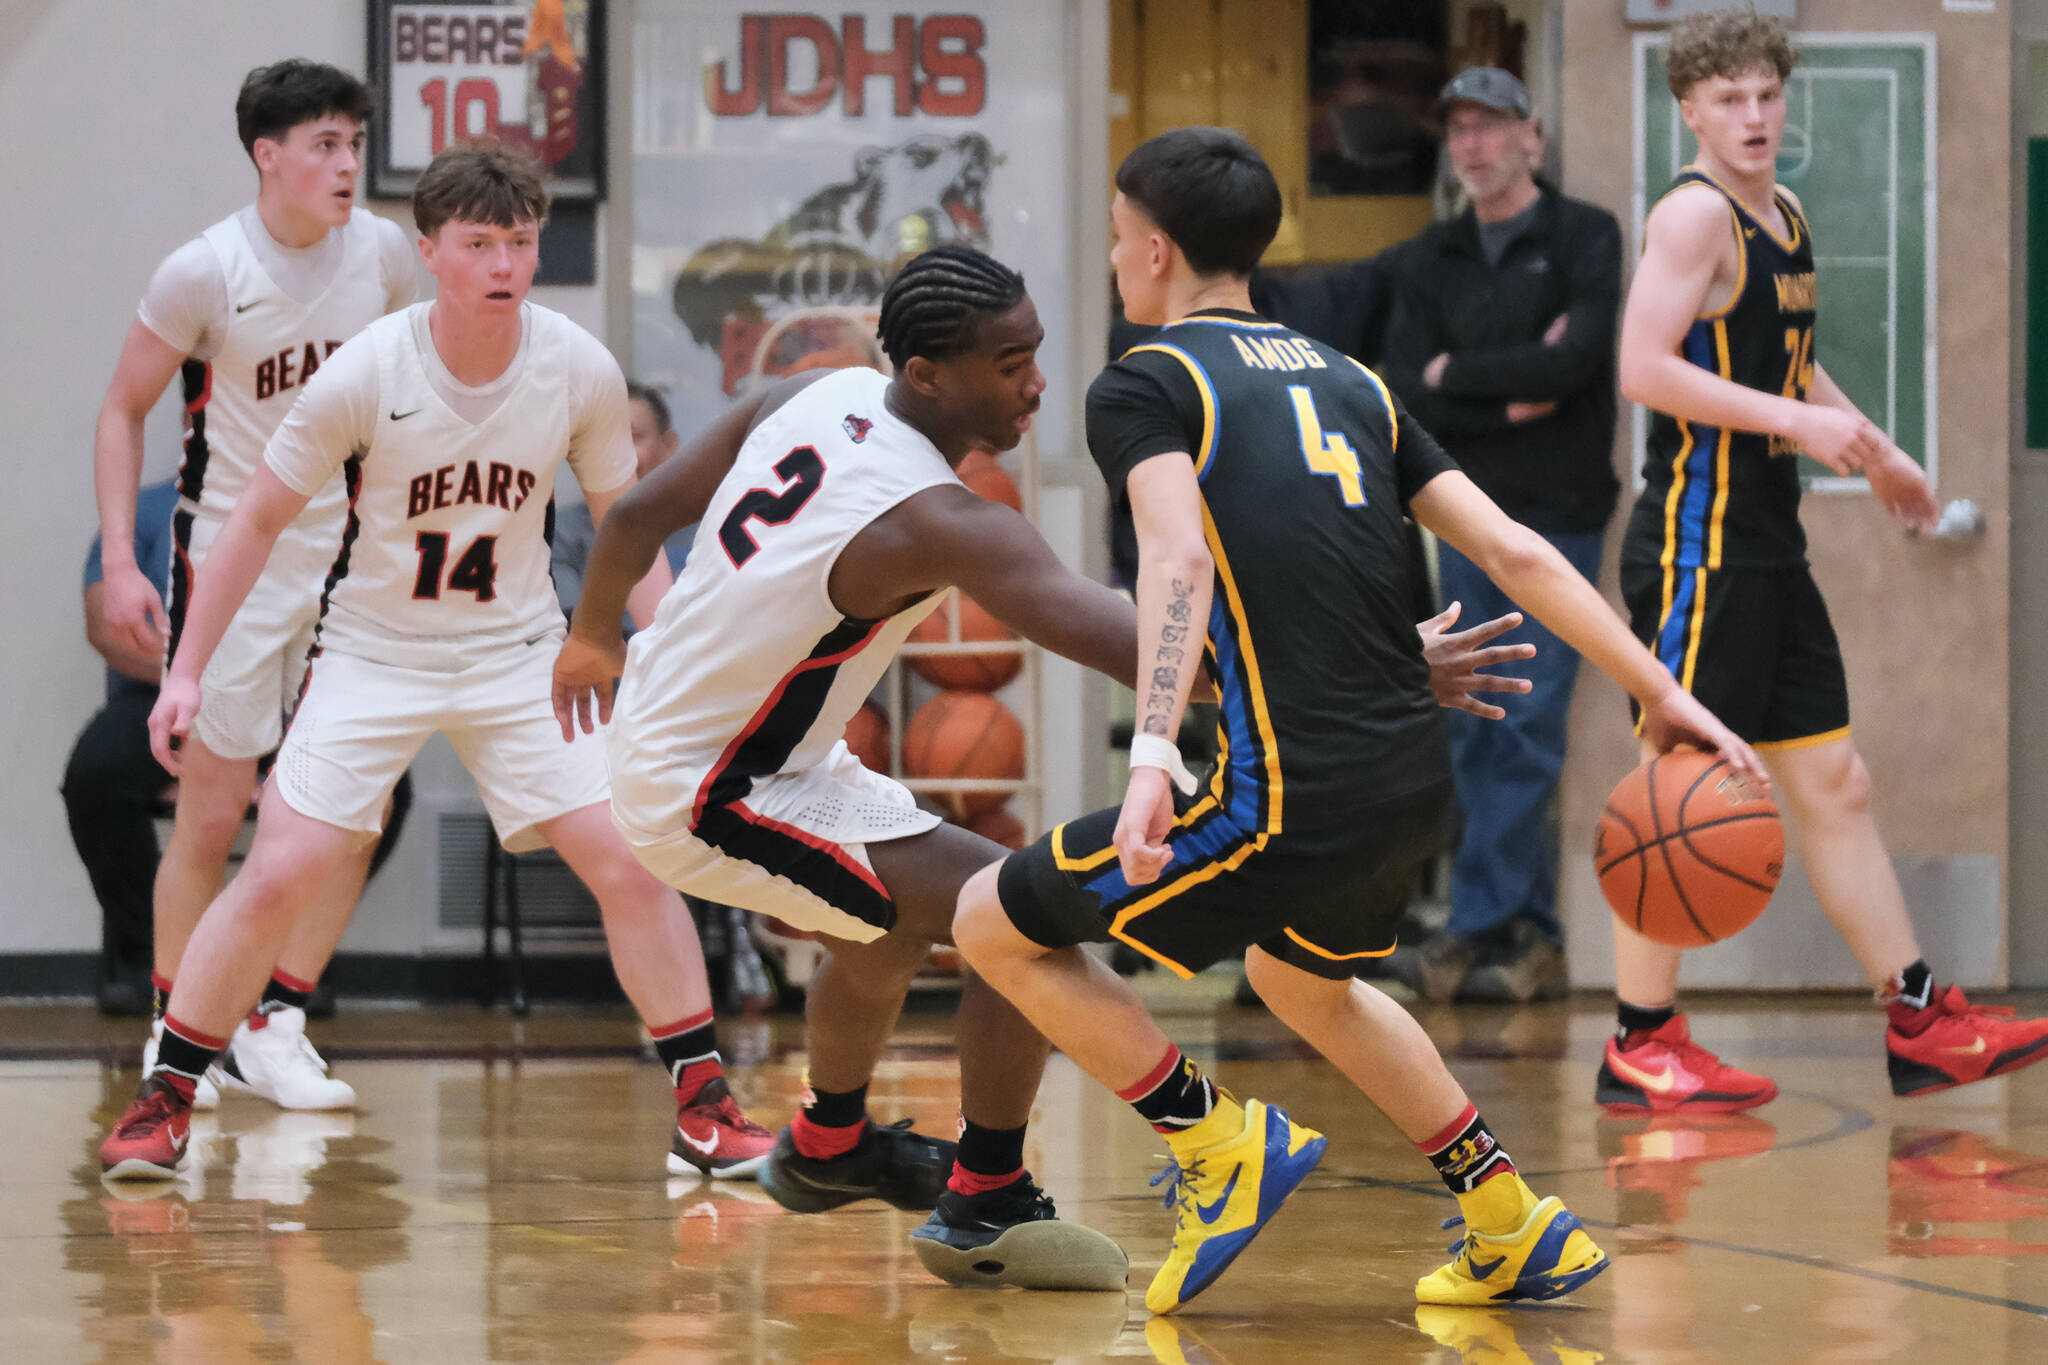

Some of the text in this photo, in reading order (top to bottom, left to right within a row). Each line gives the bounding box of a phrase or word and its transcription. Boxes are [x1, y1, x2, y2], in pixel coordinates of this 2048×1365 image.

[396, 15, 526, 66] BEARS
[702, 15, 986, 117] JDHS
[420, 77, 499, 157] 10
[1230, 334, 1328, 371] AMDG
[1287, 385, 1368, 508] 4
[407, 460, 536, 519] BEARS
[718, 444, 828, 571] 2
[412, 530, 498, 602] 14
